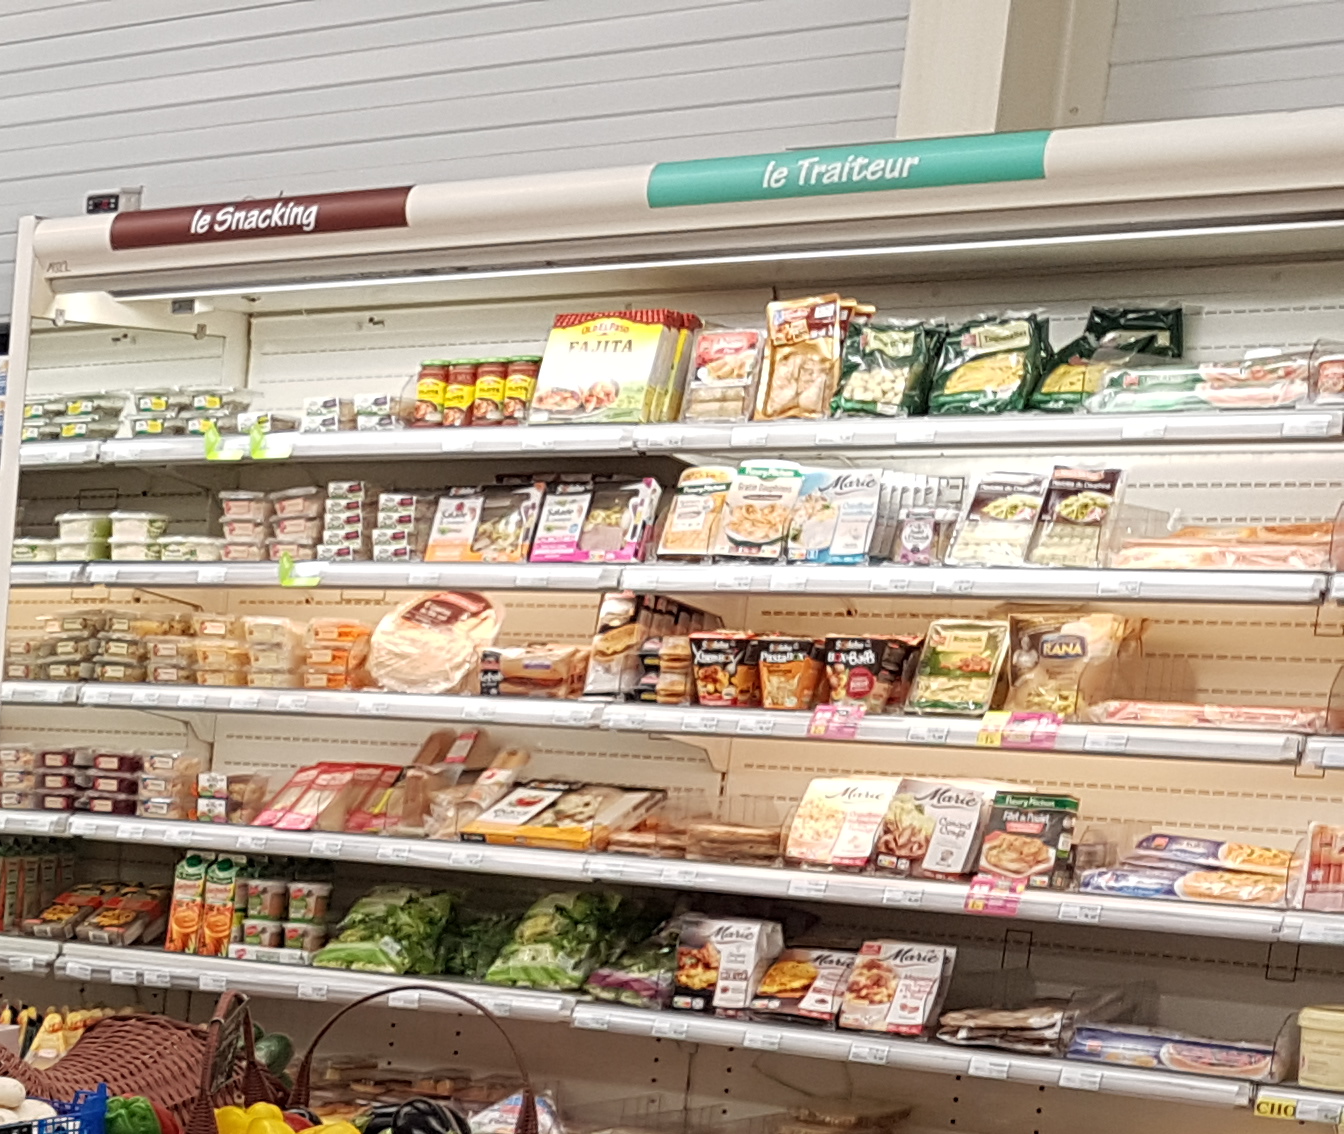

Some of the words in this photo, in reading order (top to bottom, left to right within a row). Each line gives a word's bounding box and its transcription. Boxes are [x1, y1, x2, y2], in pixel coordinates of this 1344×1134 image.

[762, 160, 786, 189] le
[797, 154, 921, 186] Traiteur
[190, 210, 210, 234] le
[214, 202, 317, 232] Snacking
[569, 339, 633, 353] FAJITA
[818, 474, 877, 492] Marie
[1043, 641, 1082, 655] RANA
[914, 787, 979, 806] Marie
[709, 925, 754, 941] Marie
[813, 954, 856, 969] Marie
[880, 948, 939, 964] Marie
